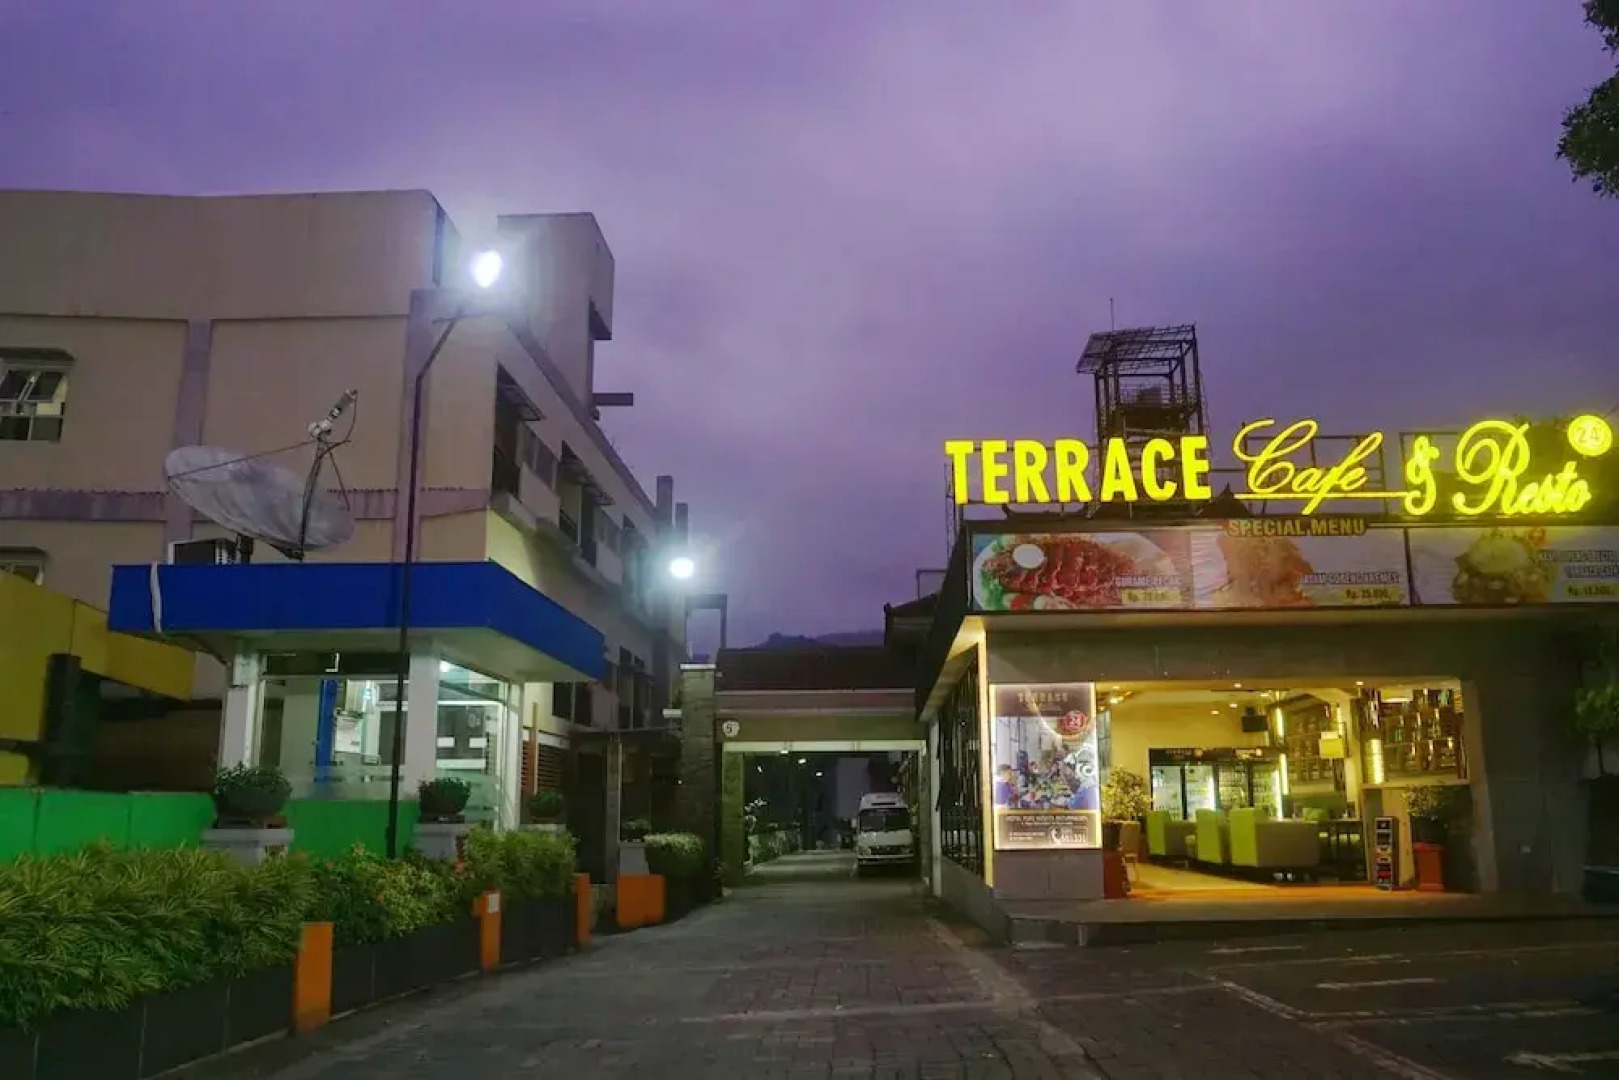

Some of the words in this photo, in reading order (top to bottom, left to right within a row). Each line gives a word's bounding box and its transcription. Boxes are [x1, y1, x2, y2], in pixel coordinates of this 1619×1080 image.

[1575, 426, 1602, 444] 24
[944, 435, 1212, 505] TERRACE
[1233, 418, 1383, 515] Cafe
[1452, 420, 1592, 515] Resto
[1227, 518, 1306, 537] SPECIAL
[1310, 517, 1365, 536] MENU
